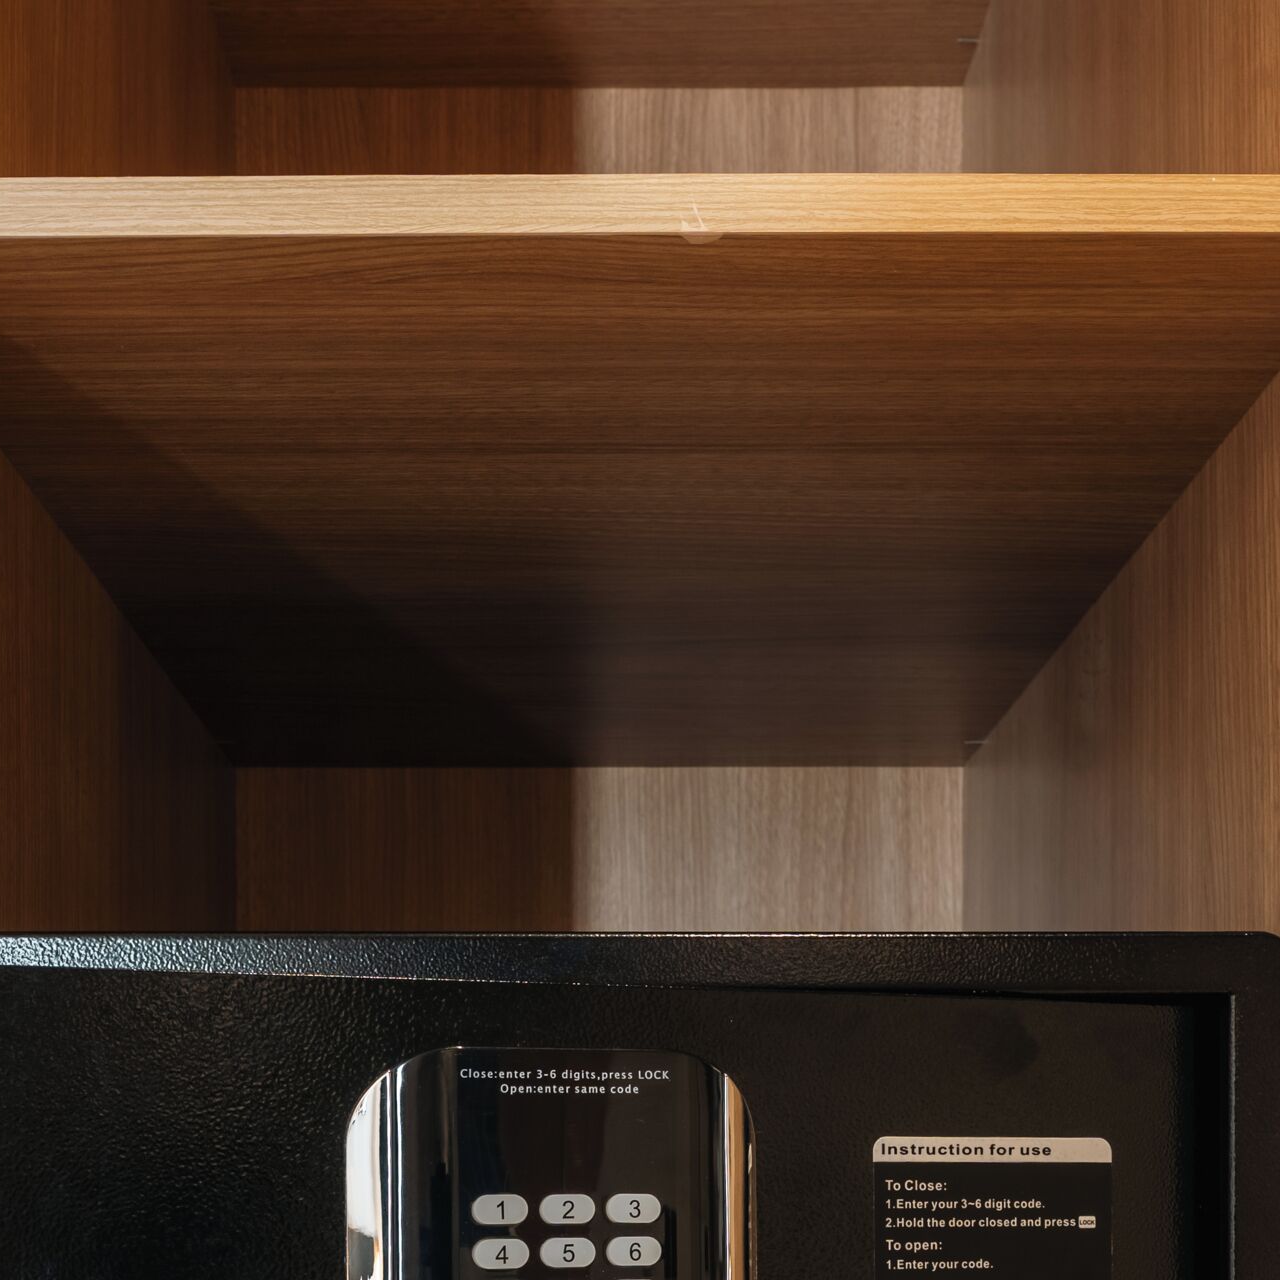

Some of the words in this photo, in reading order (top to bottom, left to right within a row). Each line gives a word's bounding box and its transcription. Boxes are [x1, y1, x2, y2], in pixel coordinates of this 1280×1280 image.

[459, 1068, 532, 1081] Close:enter
[536, 1068, 558, 1081] 3-6
[561, 1068, 634, 1083] digits,press
[637, 1068, 670, 1081] LOCK
[499, 1083, 571, 1095] Open:enter
[574, 1084, 607, 1095] same
[609, 1083, 640, 1095] code
[881, 1143, 984, 1156] Instruction
[989, 1143, 1015, 1156] for
[1020, 1143, 1052, 1156] use
[885, 1179, 901, 1191] To
[904, 1179, 948, 1192] Close:
[494, 1200, 506, 1220] 1
[561, 1200, 575, 1220] 2
[628, 1199, 642, 1219] 3
[885, 1198, 929, 1209] 1.Enter
[931, 1200, 958, 1211] your
[960, 1198, 982, 1209] 3~6
[984, 1198, 1011, 1211] digit
[1013, 1198, 1045, 1209] code.
[885, 1217, 924, 1228] 2.Hold
[927, 1217, 946, 1228] the
[948, 1217, 976, 1228] door
[978, 1217, 1018, 1227] closed
[1020, 1217, 1042, 1227] and
[1044, 1217, 1076, 1229] press
[561, 1243, 576, 1263] 5
[628, 1242, 642, 1262] 6
[886, 1239, 902, 1251] To
[905, 1241, 943, 1253] open:
[494, 1245, 510, 1264] 4
[886, 1259, 929, 1270] 1.Enter
[931, 1260, 959, 1272] your
[961, 1258, 994, 1270] code.
